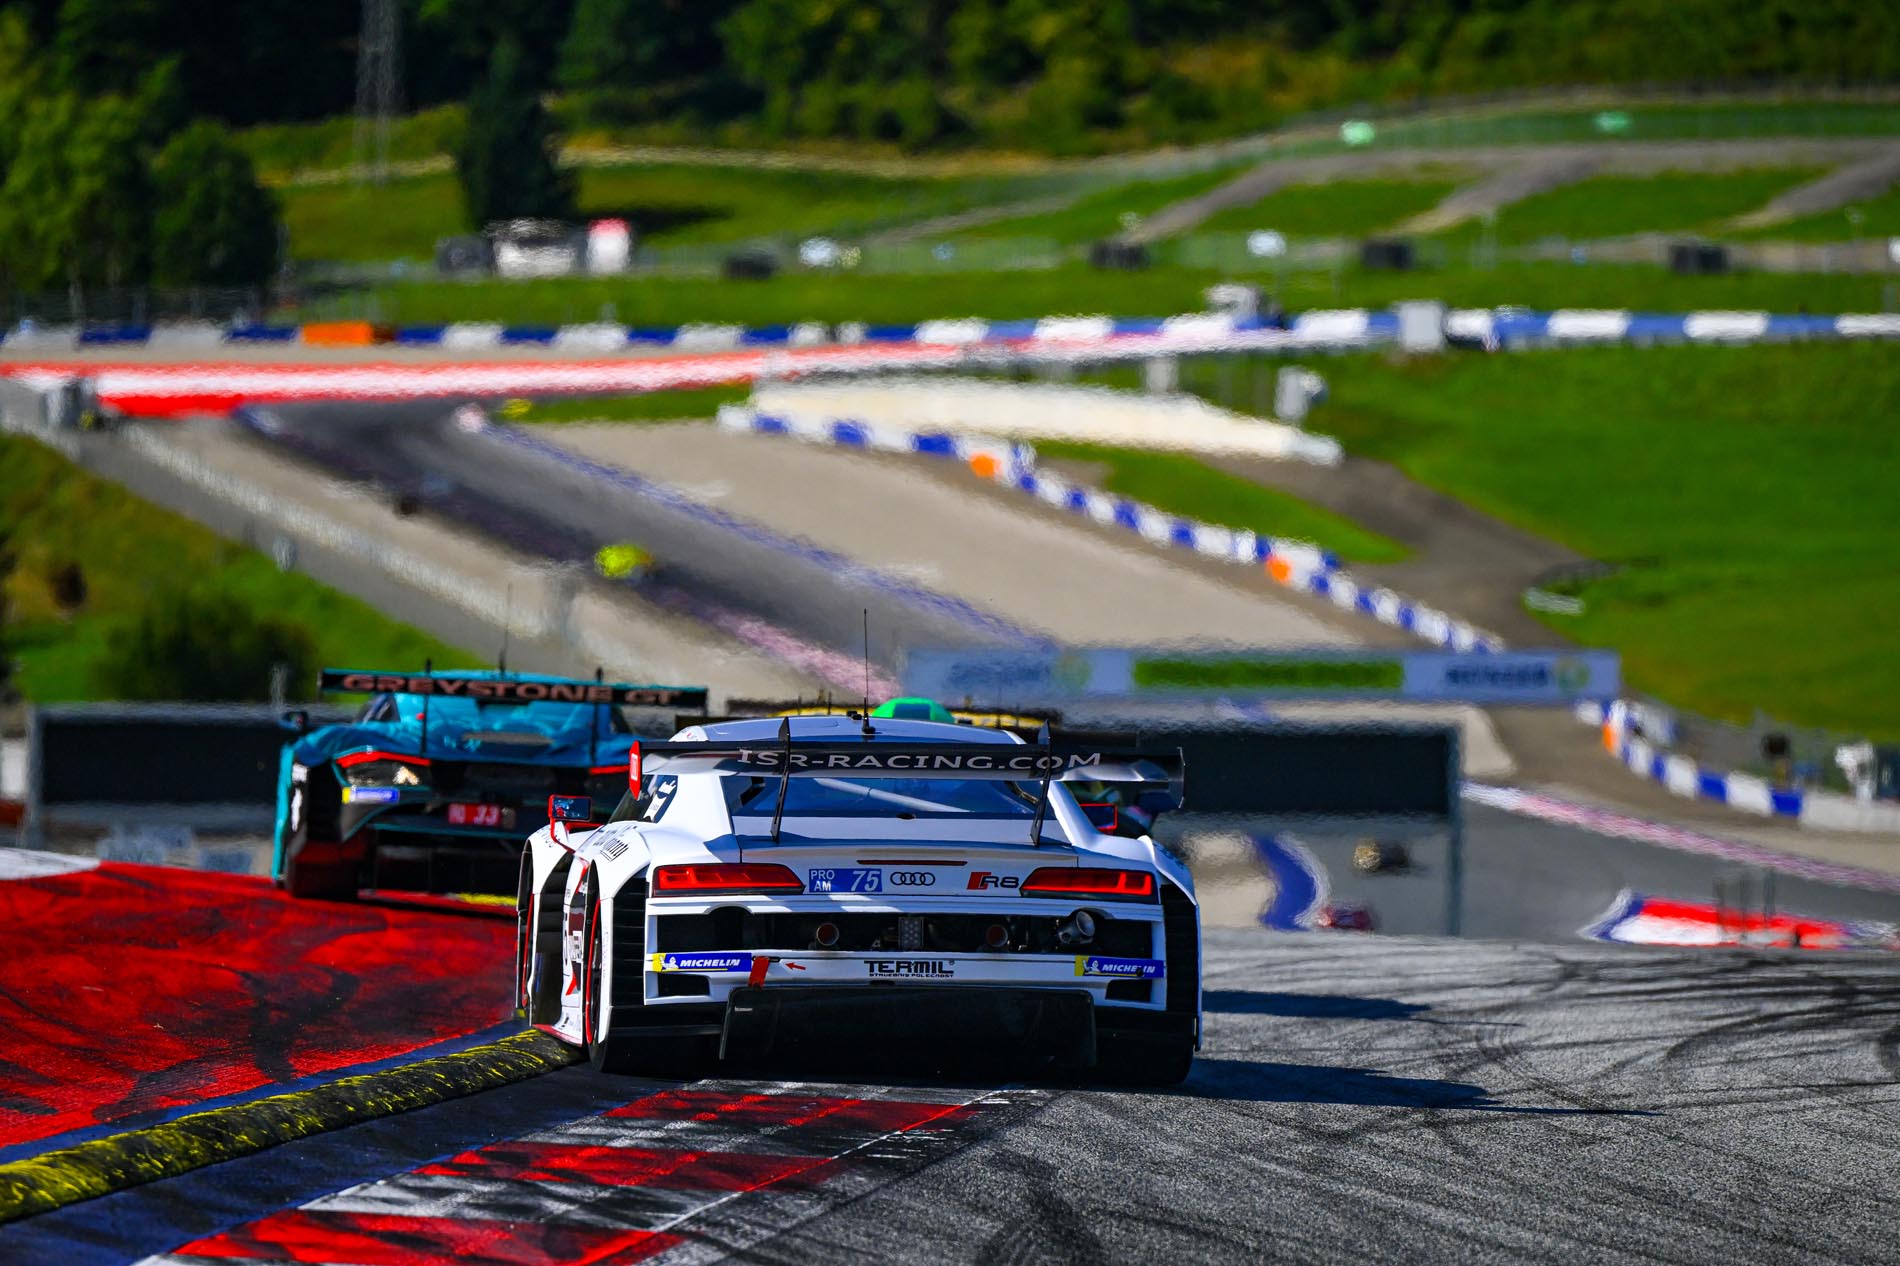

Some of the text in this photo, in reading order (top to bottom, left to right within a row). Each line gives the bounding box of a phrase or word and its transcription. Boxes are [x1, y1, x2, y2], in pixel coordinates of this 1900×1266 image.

[343, 674, 683, 704] GREYSTONE GT
[737, 748, 1101, 770] ISR-RACING.COM
[810, 869, 835, 880] PRO
[850, 870, 880, 892] 75
[813, 880, 832, 892] AM
[981, 875, 1020, 889] R8
[680, 958, 740, 967] MICHELIN
[863, 960, 955, 974] TERMIL
